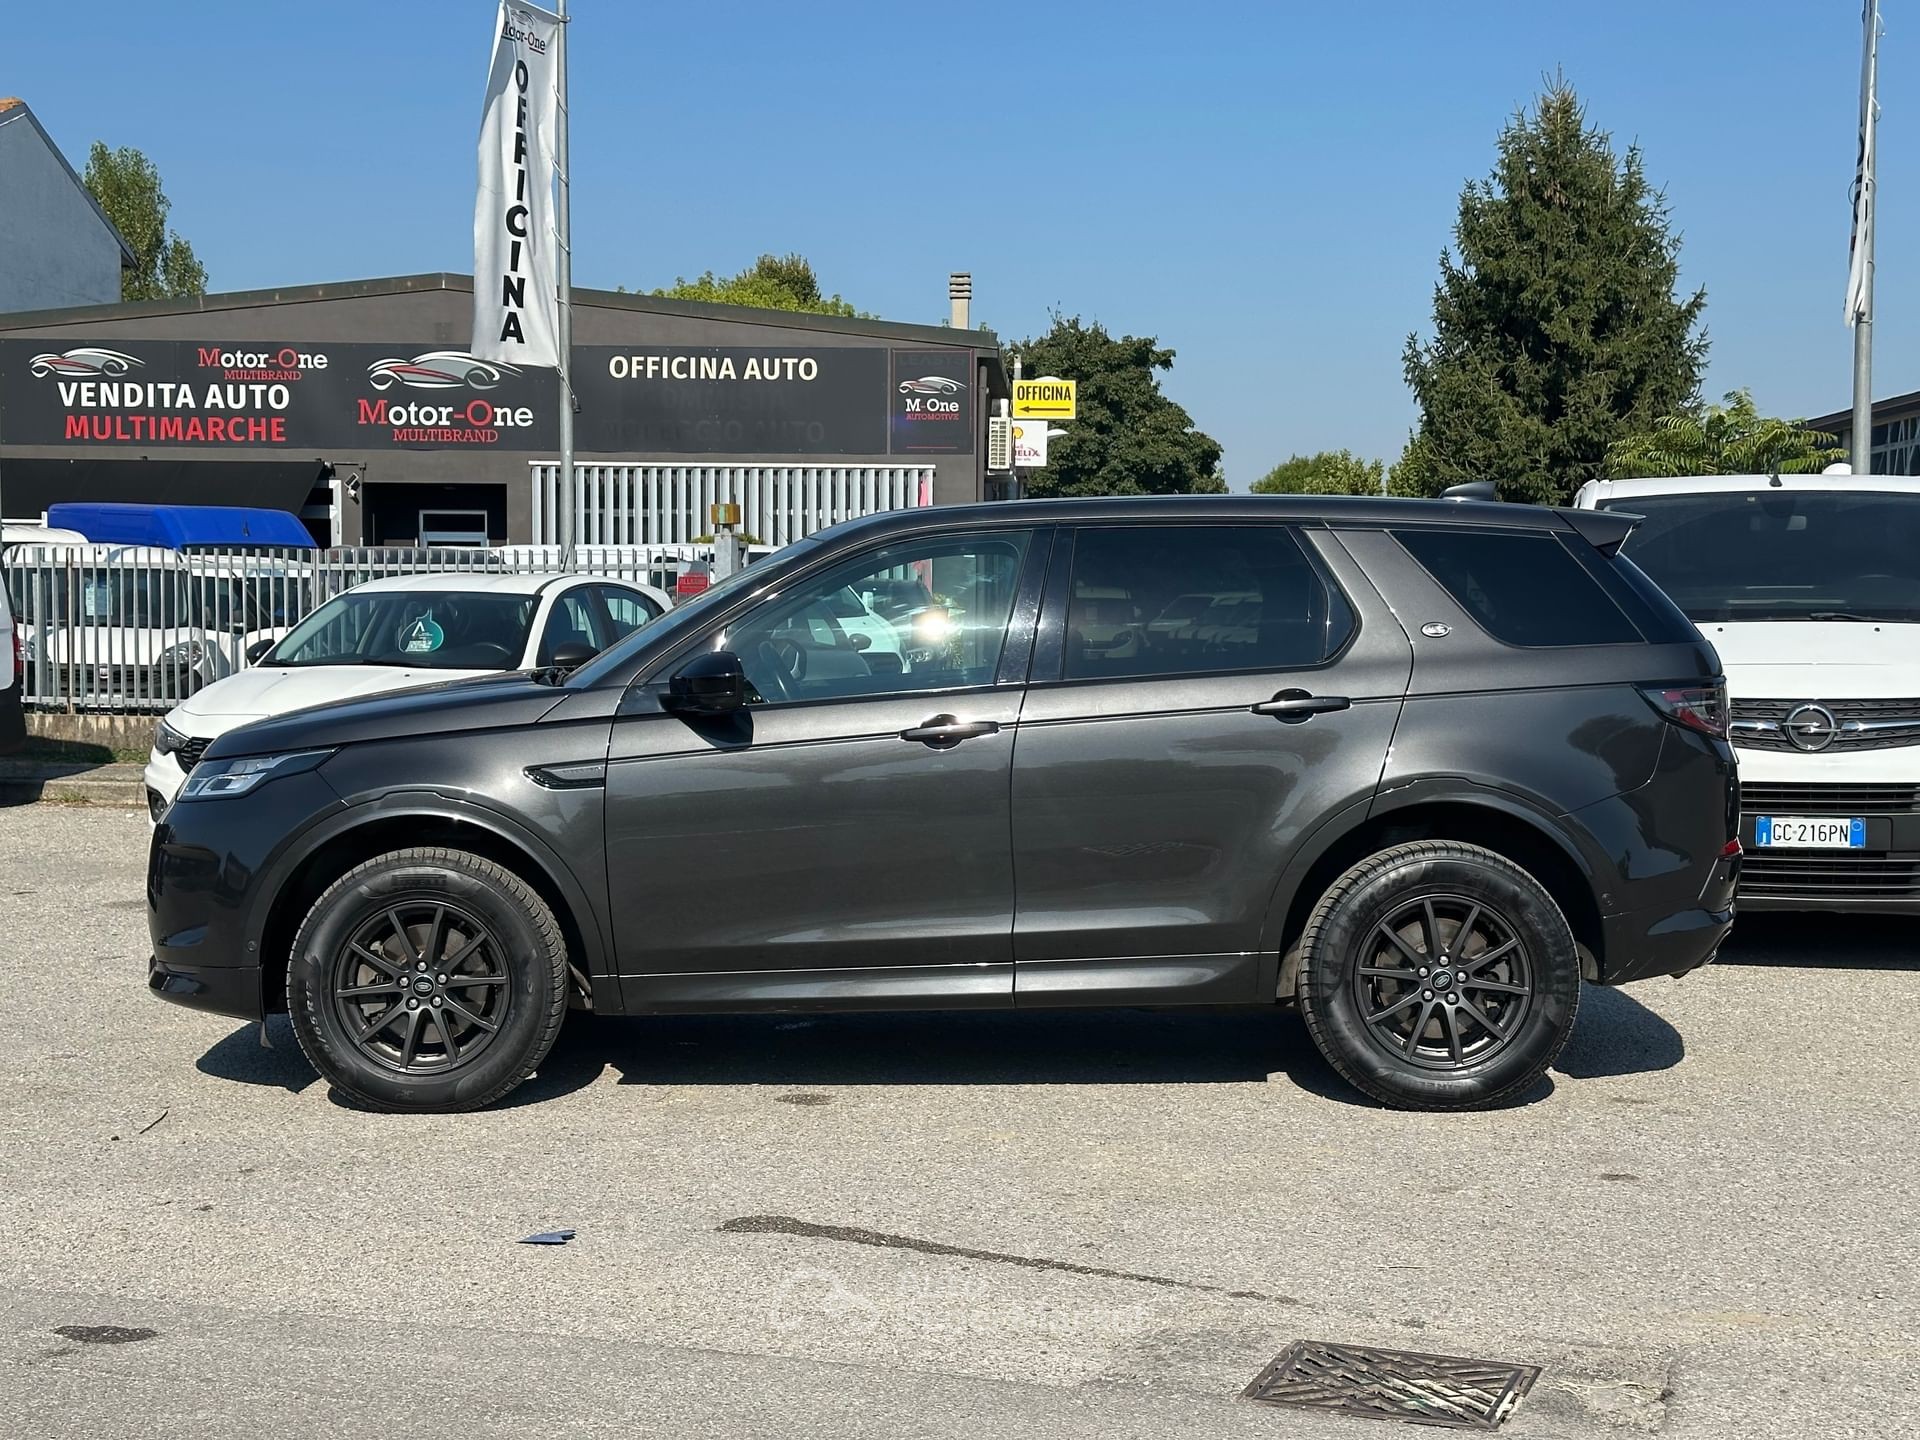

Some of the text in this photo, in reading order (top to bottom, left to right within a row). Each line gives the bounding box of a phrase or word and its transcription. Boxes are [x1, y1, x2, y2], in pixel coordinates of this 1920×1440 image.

[500, 59, 529, 344] OFFICINA
[198, 347, 328, 369] Motor-One
[224, 370, 302, 380] MULTIBRAND
[609, 355, 818, 381] OFFICINA AUTO
[58, 382, 290, 410] VENDITA AUTO
[1017, 385, 1072, 401] OFFICINA
[357, 399, 534, 427] Motor-One
[905, 398, 960, 412] M-One
[906, 413, 960, 421] AUTOMOTIVE
[65, 415, 287, 441] MULTIMARCHE
[393, 429, 498, 443] MULTIBRAND
[1015, 449, 1041, 457] ELIX
